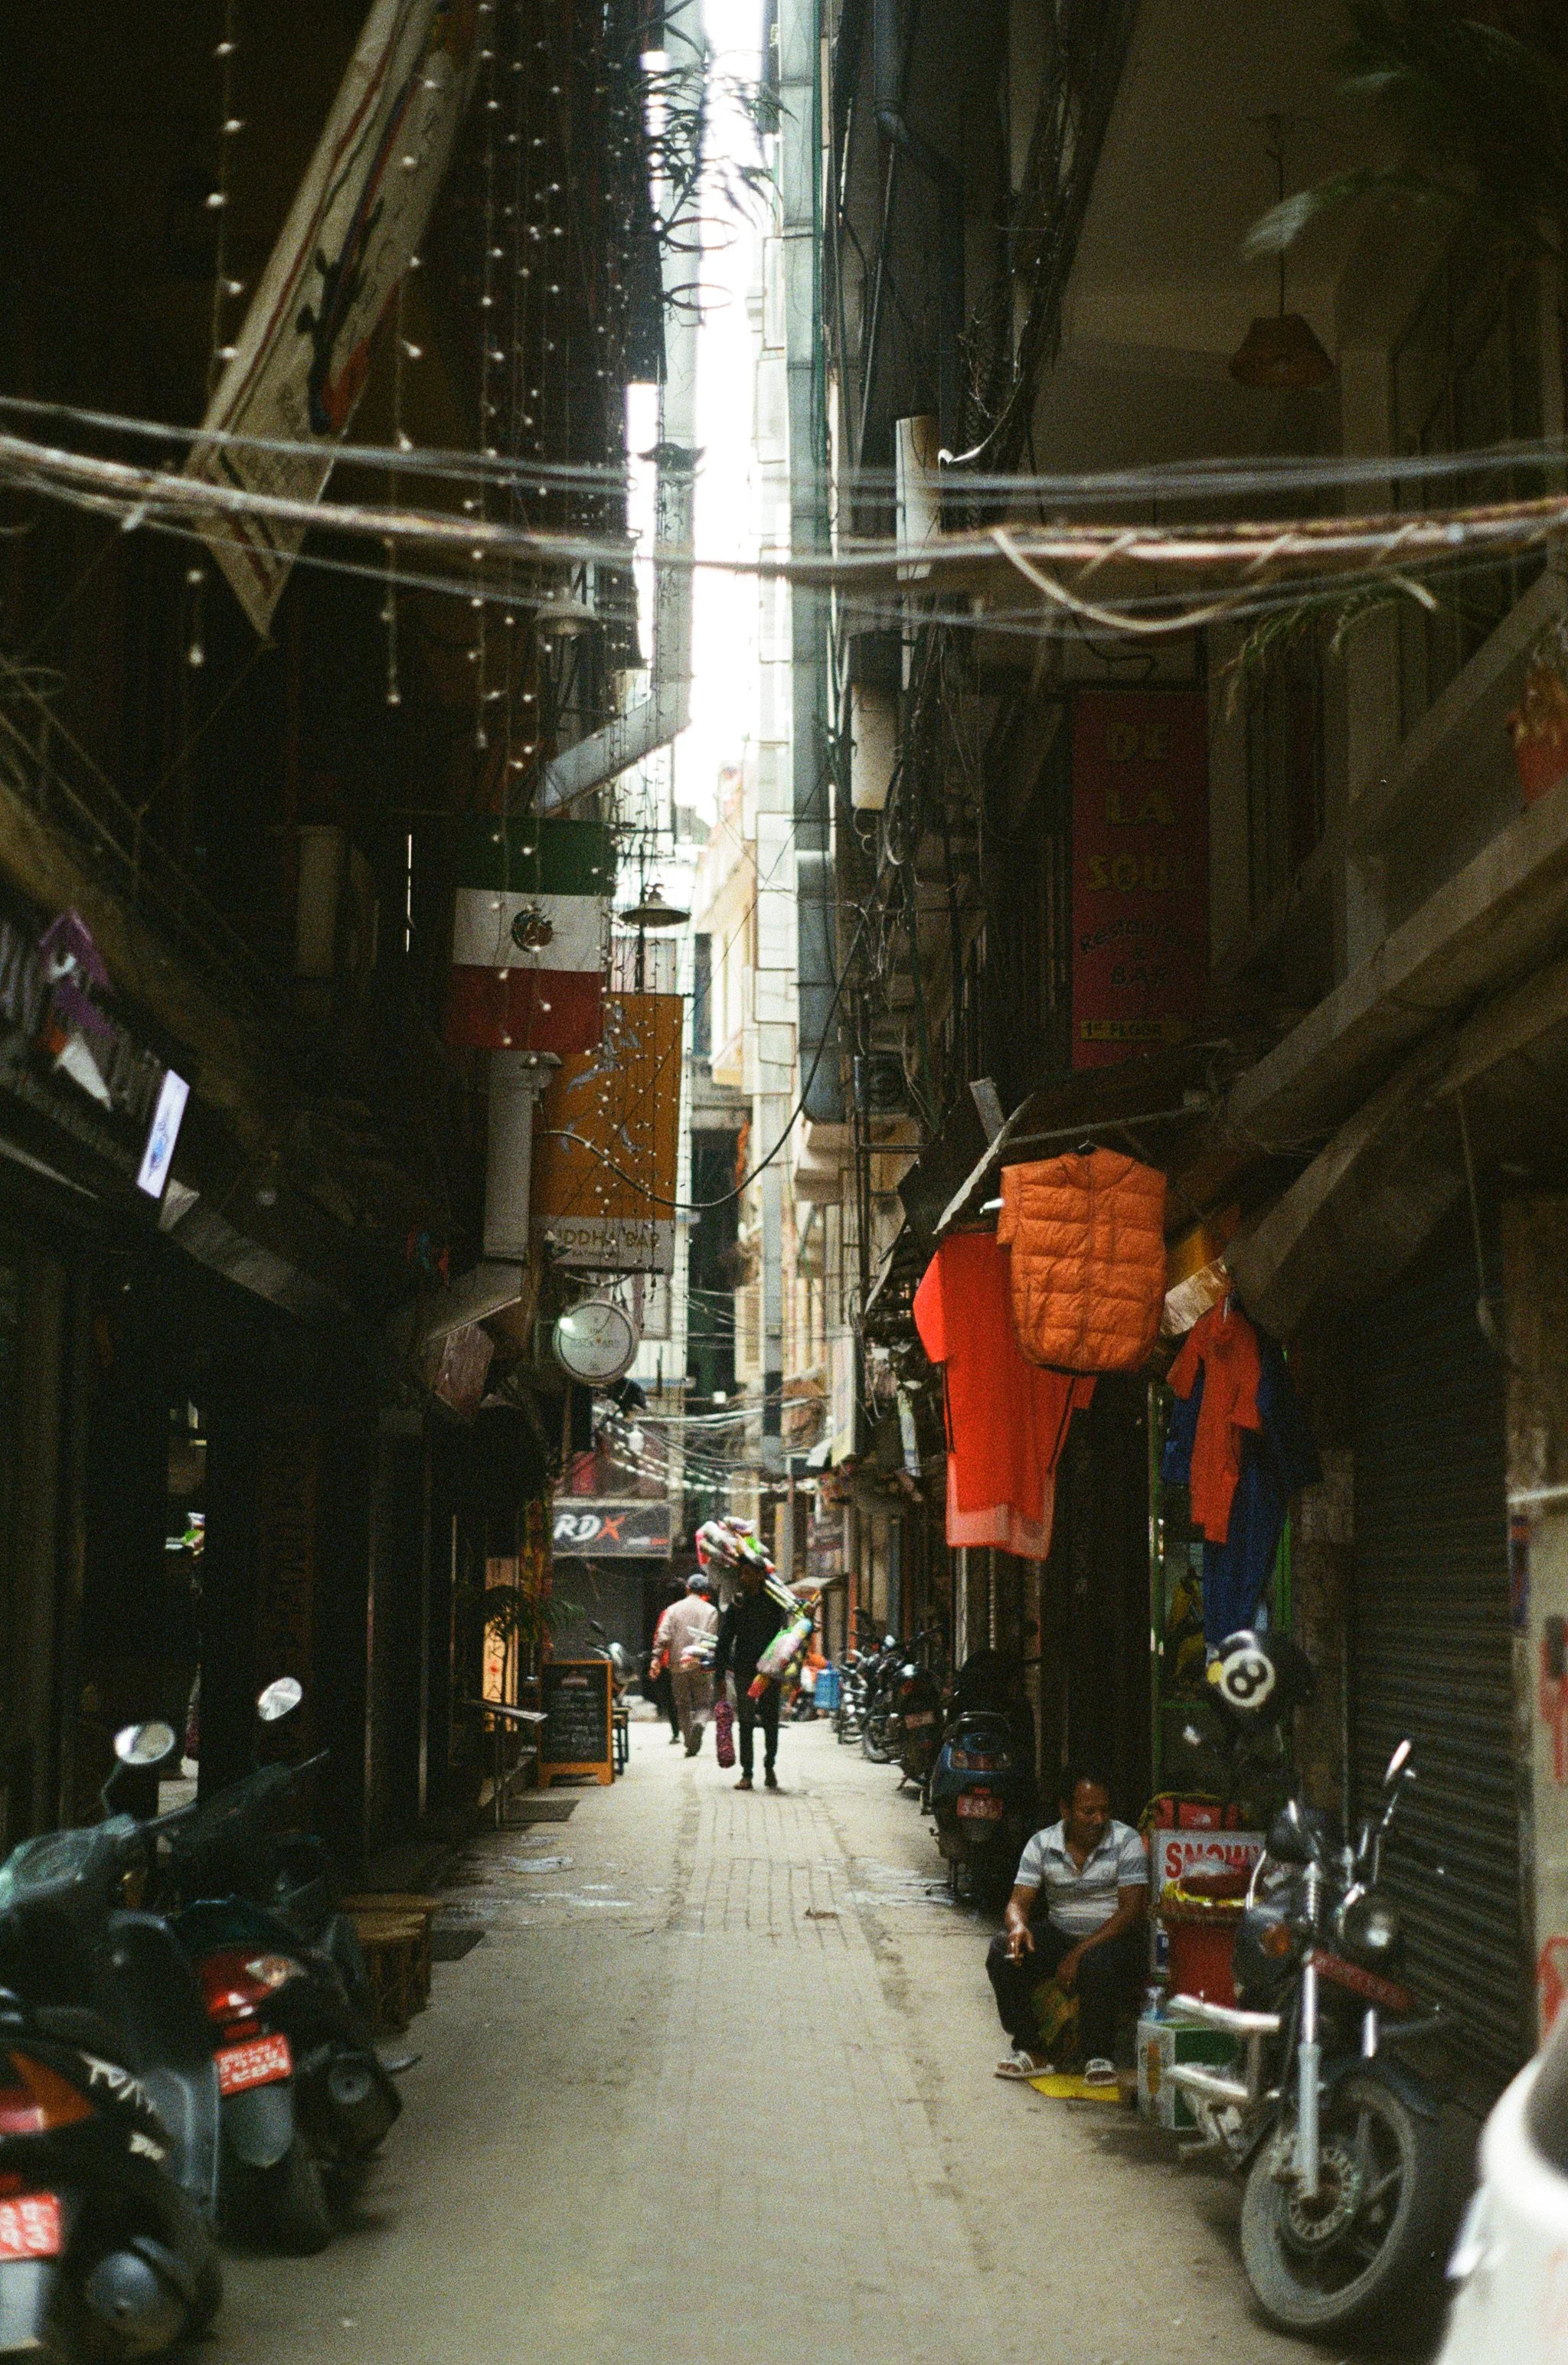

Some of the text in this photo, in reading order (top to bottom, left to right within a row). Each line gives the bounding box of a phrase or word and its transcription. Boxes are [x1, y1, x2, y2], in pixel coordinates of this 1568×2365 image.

[1105, 722, 1171, 763] DE
[1106, 789, 1175, 827] LA
[1086, 853, 1197, 892] SOUL
[553, 1514, 626, 1543] RDX
